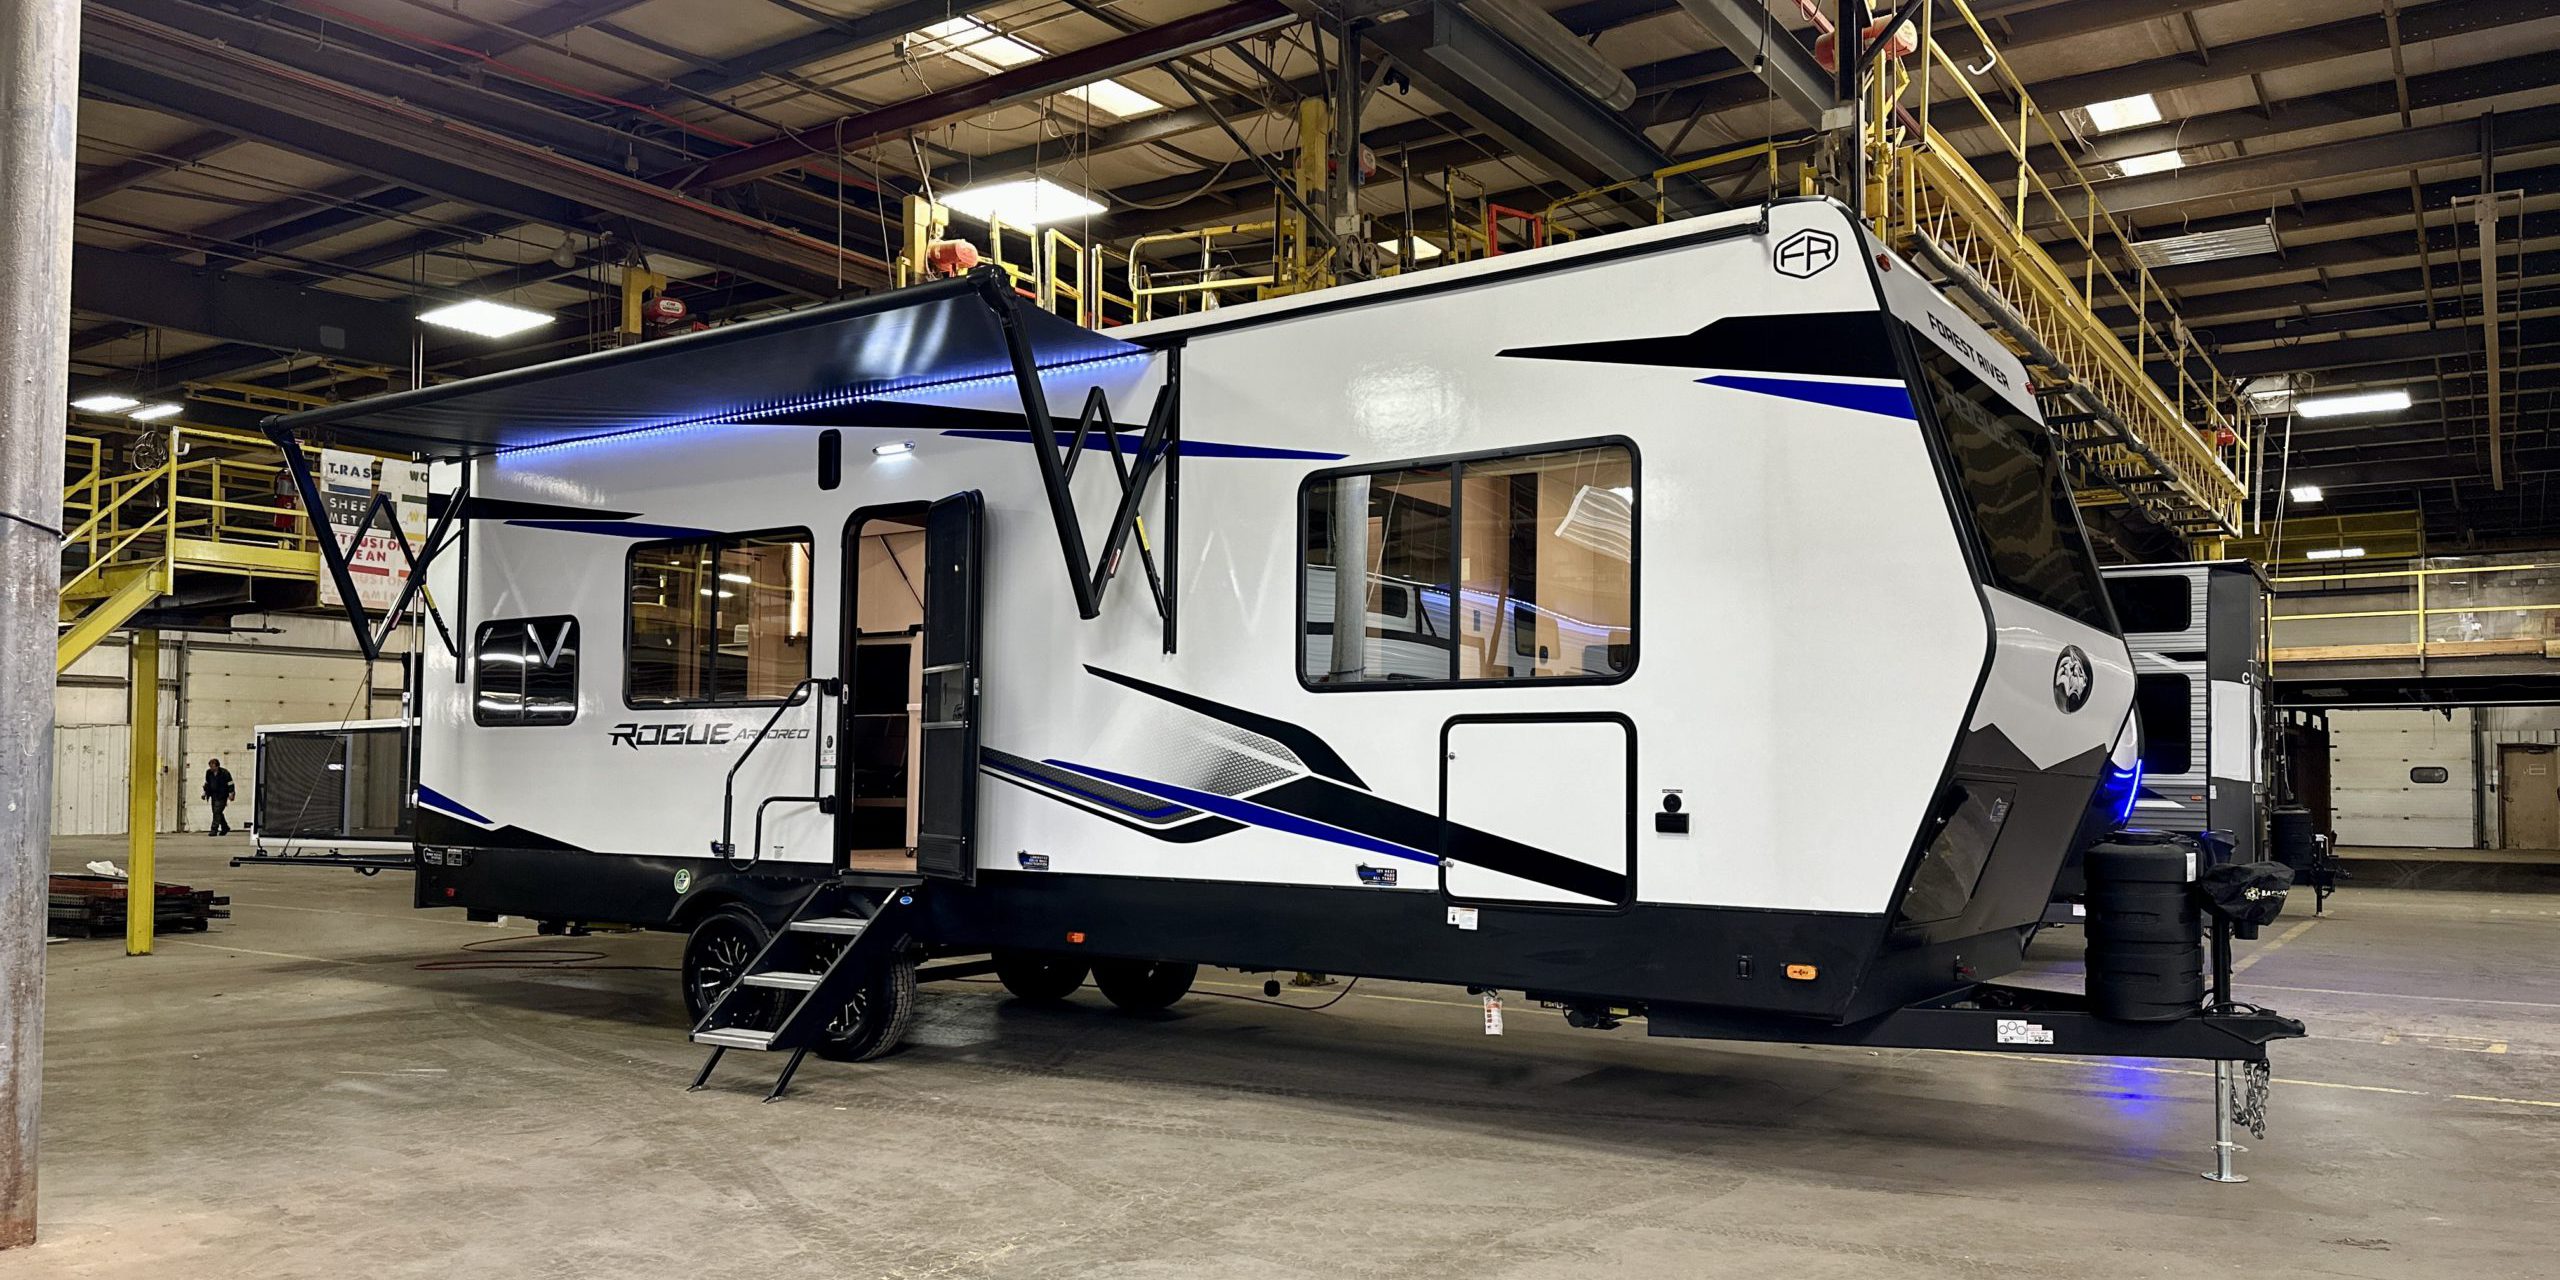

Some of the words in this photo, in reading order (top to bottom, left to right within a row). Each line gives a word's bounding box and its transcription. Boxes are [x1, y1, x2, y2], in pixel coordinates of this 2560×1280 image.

[1781, 236, 1831, 271] FR
[1927, 311, 1975, 362] FOREST
[1976, 351, 2011, 391] RIVER
[328, 462, 371, 479] TRAS
[409, 470, 428, 482] WO
[329, 498, 367, 512] SHEE
[328, 512, 378, 528] METL
[608, 723, 733, 750] ROGUE
[734, 728, 809, 741] ARORED
